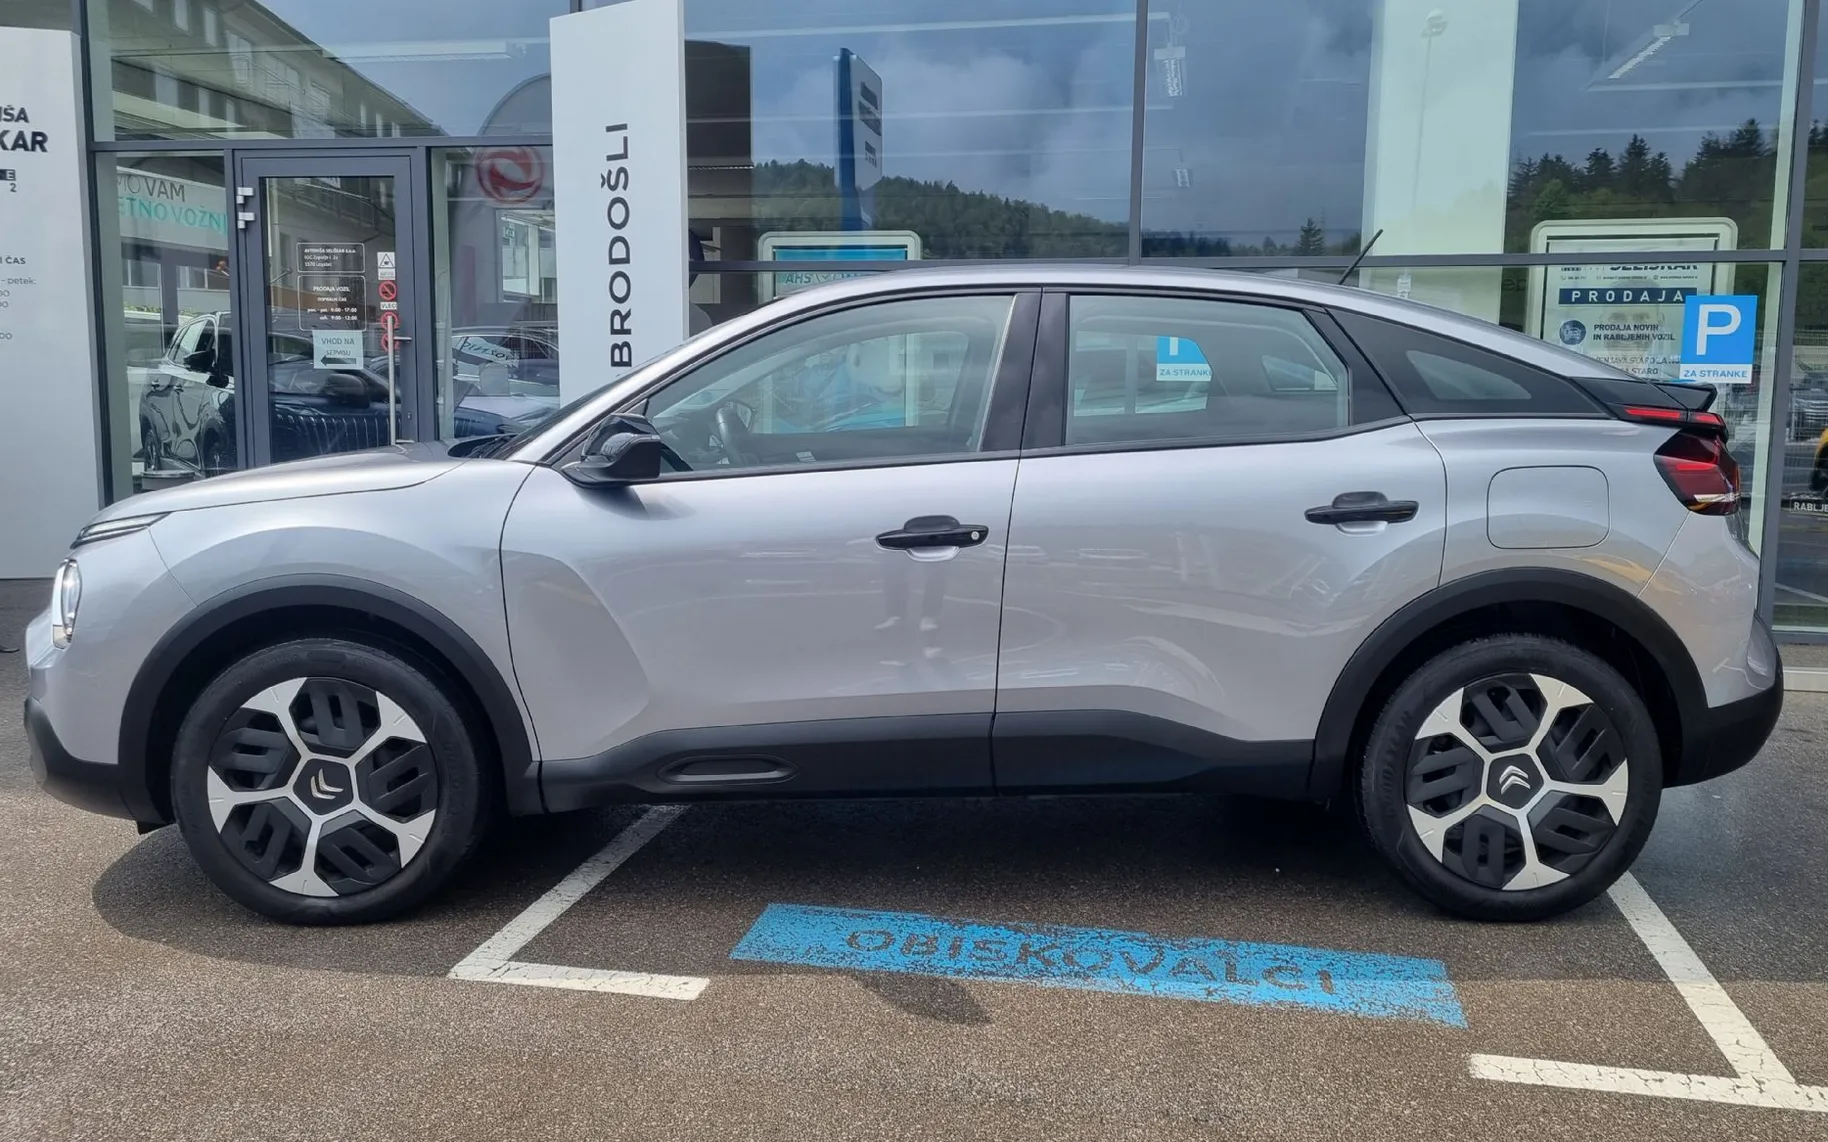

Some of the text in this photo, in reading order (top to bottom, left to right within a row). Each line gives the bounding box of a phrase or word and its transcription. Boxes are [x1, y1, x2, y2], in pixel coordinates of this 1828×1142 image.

[9, 183, 17, 193] 2
[145, 178, 185, 202] VAM
[601, 123, 632, 368] BRODOŠLI
[5, 255, 26, 265] ČAS
[1571, 290, 1684, 302] PRODAJA
[1696, 304, 1742, 356] P
[1160, 369, 1171, 377] ZA
[1683, 369, 1748, 378] ZA STRANKE
[848, 929, 1337, 994] OBISKOVALCI
